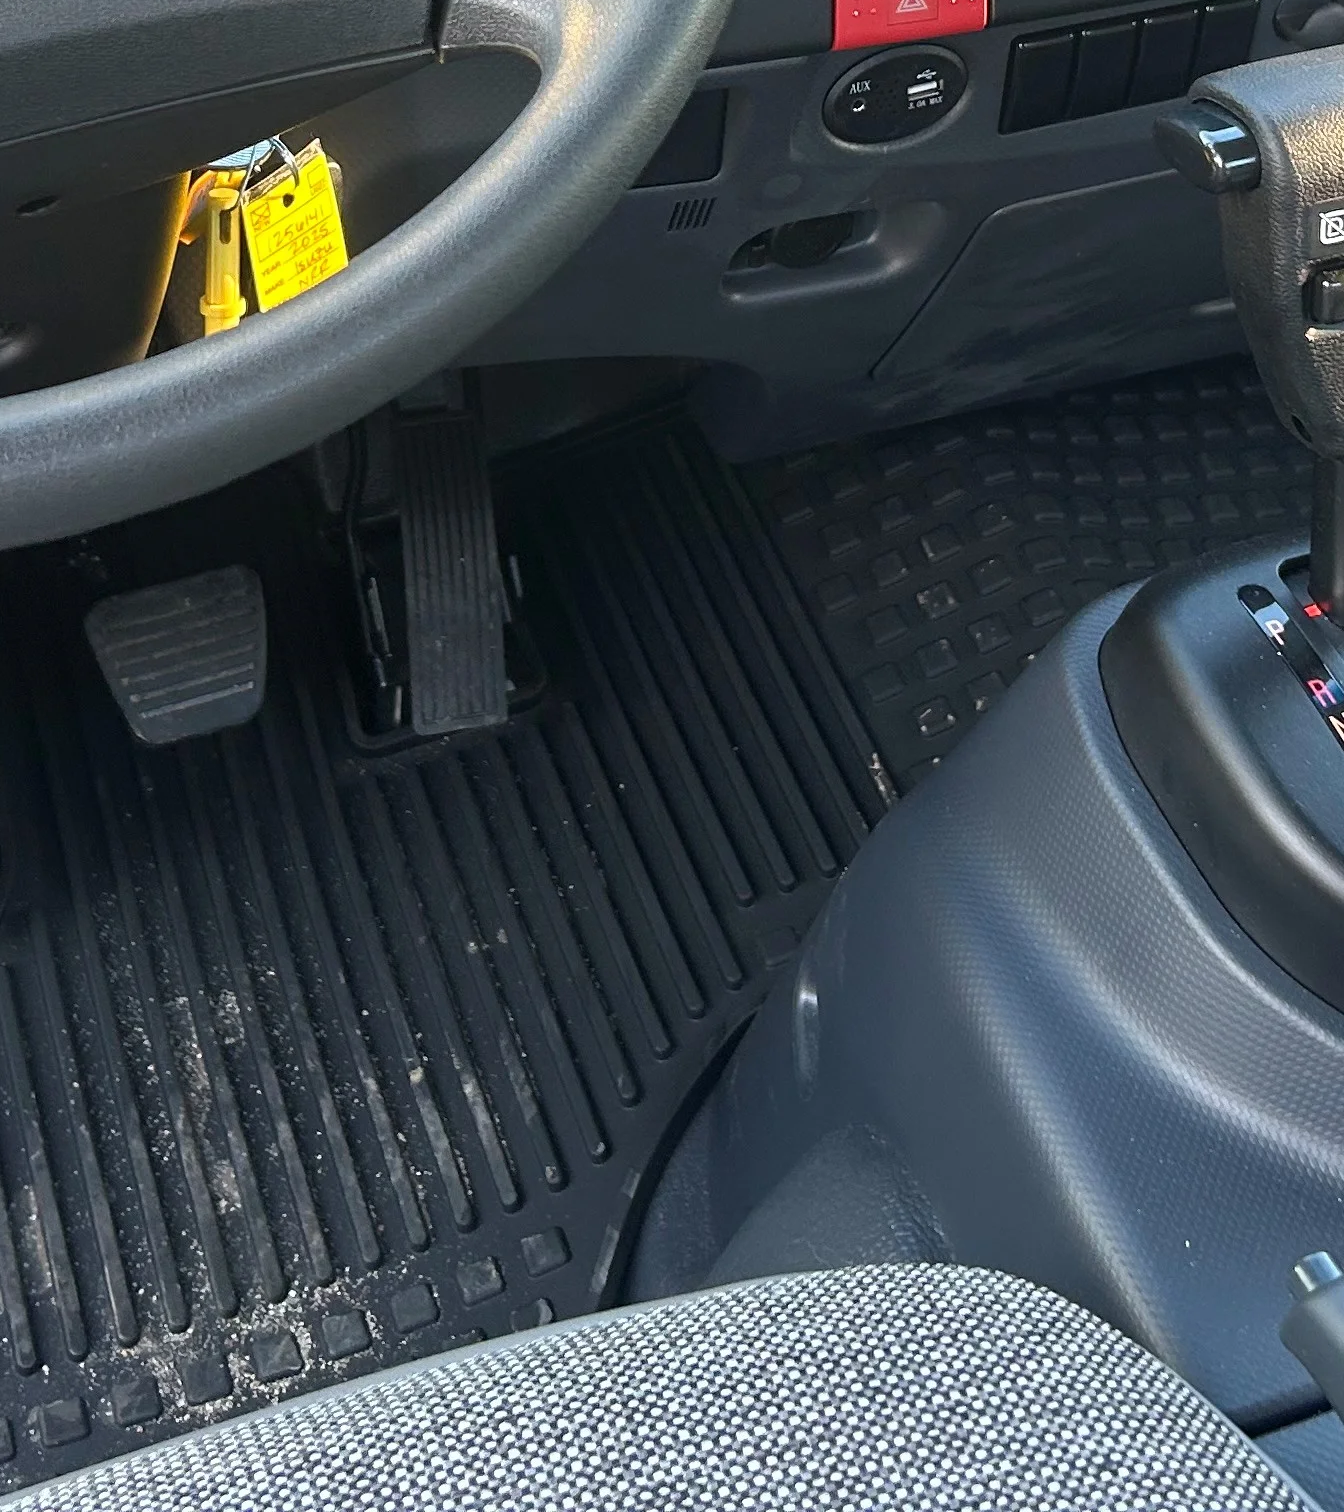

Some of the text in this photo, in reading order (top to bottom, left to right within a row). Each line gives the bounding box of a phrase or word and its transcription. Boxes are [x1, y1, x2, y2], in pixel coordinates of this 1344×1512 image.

[849, 80, 871, 95] AUX
[1264, 619, 1285, 646] P
[1306, 677, 1338, 709] R
